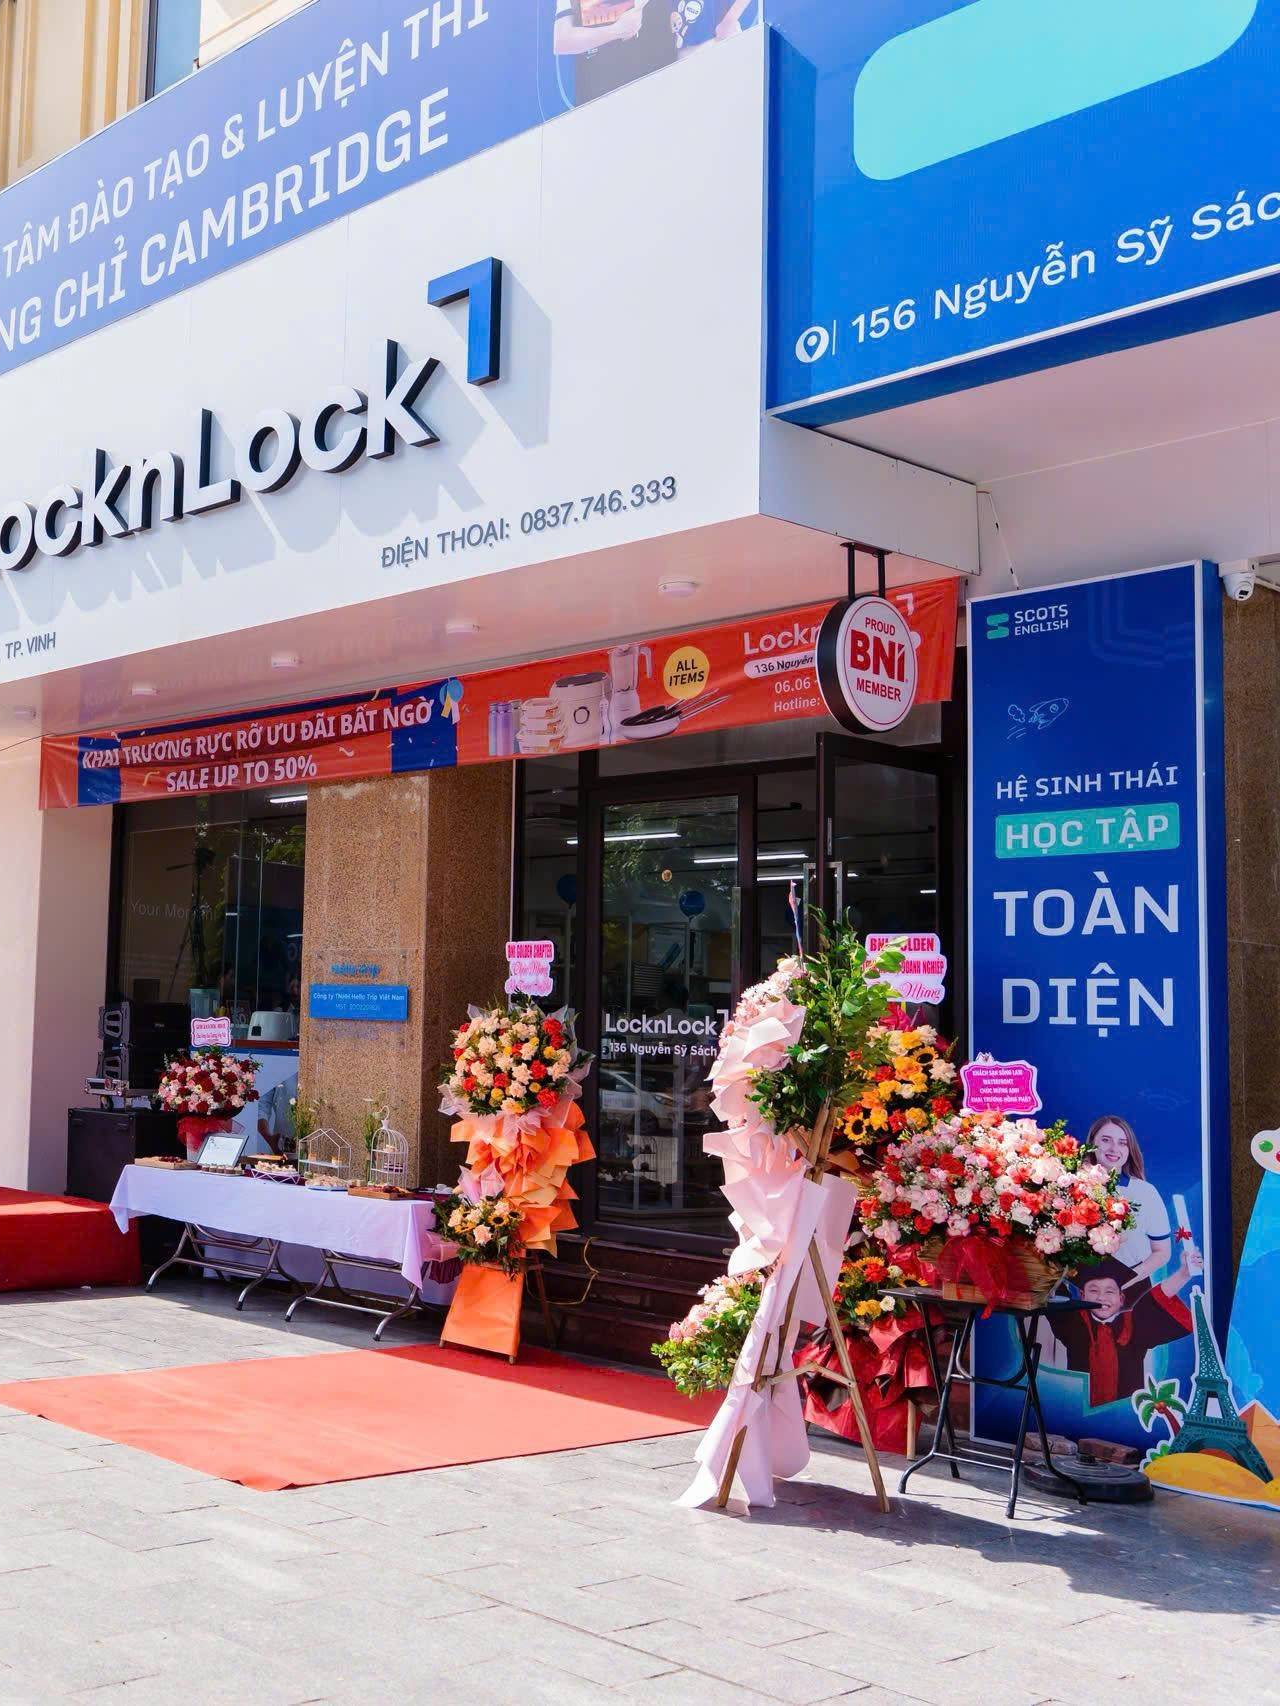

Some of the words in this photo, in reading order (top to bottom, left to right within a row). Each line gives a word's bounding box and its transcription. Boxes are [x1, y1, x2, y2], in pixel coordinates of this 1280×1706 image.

[3, 216, 59, 278] TÂM
[68, 176, 134, 244] ĐÀO
[144, 134, 210, 200] TẠO
[221, 113, 245, 159] &
[258, 30, 389, 142] LUYỆN
[404, 0, 488, 59] THI
[54, 235, 127, 327] CHỈ
[140, 87, 448, 286] CAMBRIDGE
[851, 299, 915, 343] 156
[934, 241, 1096, 319] Nguyễn
[1116, 216, 1173, 265] Sỹ
[381, 536, 428, 568] ĐIỆN
[437, 518, 510, 554] THOẠI:
[520, 476, 677, 535] 0837.746.333
[865, 616, 896, 636] PROUD
[1014, 604, 1069, 624] SCOTS
[1014, 619, 1069, 636] ENGLISH
[5, 640, 24, 660] TP.
[27, 631, 56, 655] VINH
[676, 658, 698, 671] ALL
[754, 663, 775, 673] 136
[669, 670, 705, 687] ITEMS
[774, 677, 811, 693] 06.06
[856, 677, 902, 702] MEMBER
[774, 697, 820, 712] Hotline:
[82, 749, 120, 769] KHAI
[123, 738, 191, 765] TRƯƠNG
[195, 731, 232, 759] RỰC
[236, 725, 263, 750] RỠ
[267, 721, 296, 745] ƯU
[300, 713, 336, 741] ĐÃI
[340, 705, 378, 734] BẤT
[383, 699, 434, 728] NGỜ
[165, 767, 209, 793] SALE
[213, 764, 239, 786] UP
[244, 761, 269, 784] TO
[273, 754, 317, 778] 50%
[997, 775, 1028, 801] HỆ
[1035, 773, 1101, 797] SINH
[1110, 762, 1178, 791] THÁI
[1007, 820, 1083, 854] HỌC
[1096, 809, 1168, 849] TẬP
[993, 871, 1179, 937] TOÀN
[1002, 962, 1174, 1037] DIỆN
[606, 1013, 717, 1035] LocknLock
[610, 1042, 626, 1053] 136
[630, 1041, 671, 1055] Nguyễn
[674, 1044, 687, 1057] Sỹ
[691, 1044, 717, 1056] Sách
